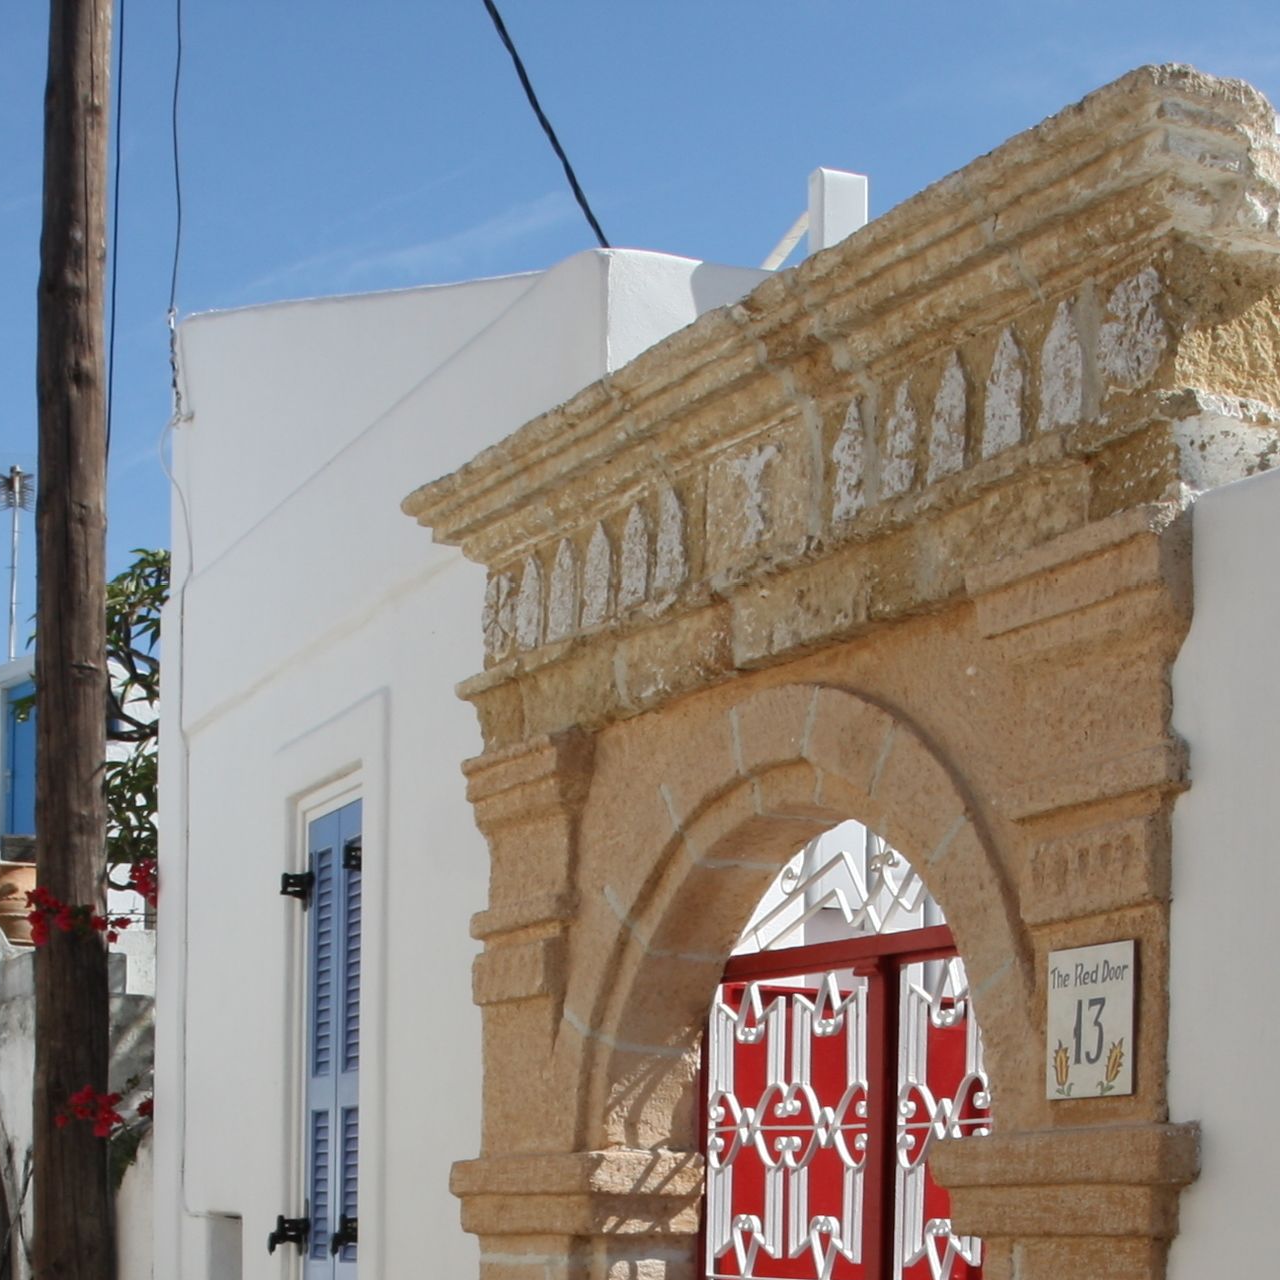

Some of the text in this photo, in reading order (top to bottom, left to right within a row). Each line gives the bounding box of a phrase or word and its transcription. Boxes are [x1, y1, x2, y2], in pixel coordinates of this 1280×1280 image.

[1050, 960, 1128, 989] The Red Door
[1073, 997, 1106, 1065] 13
